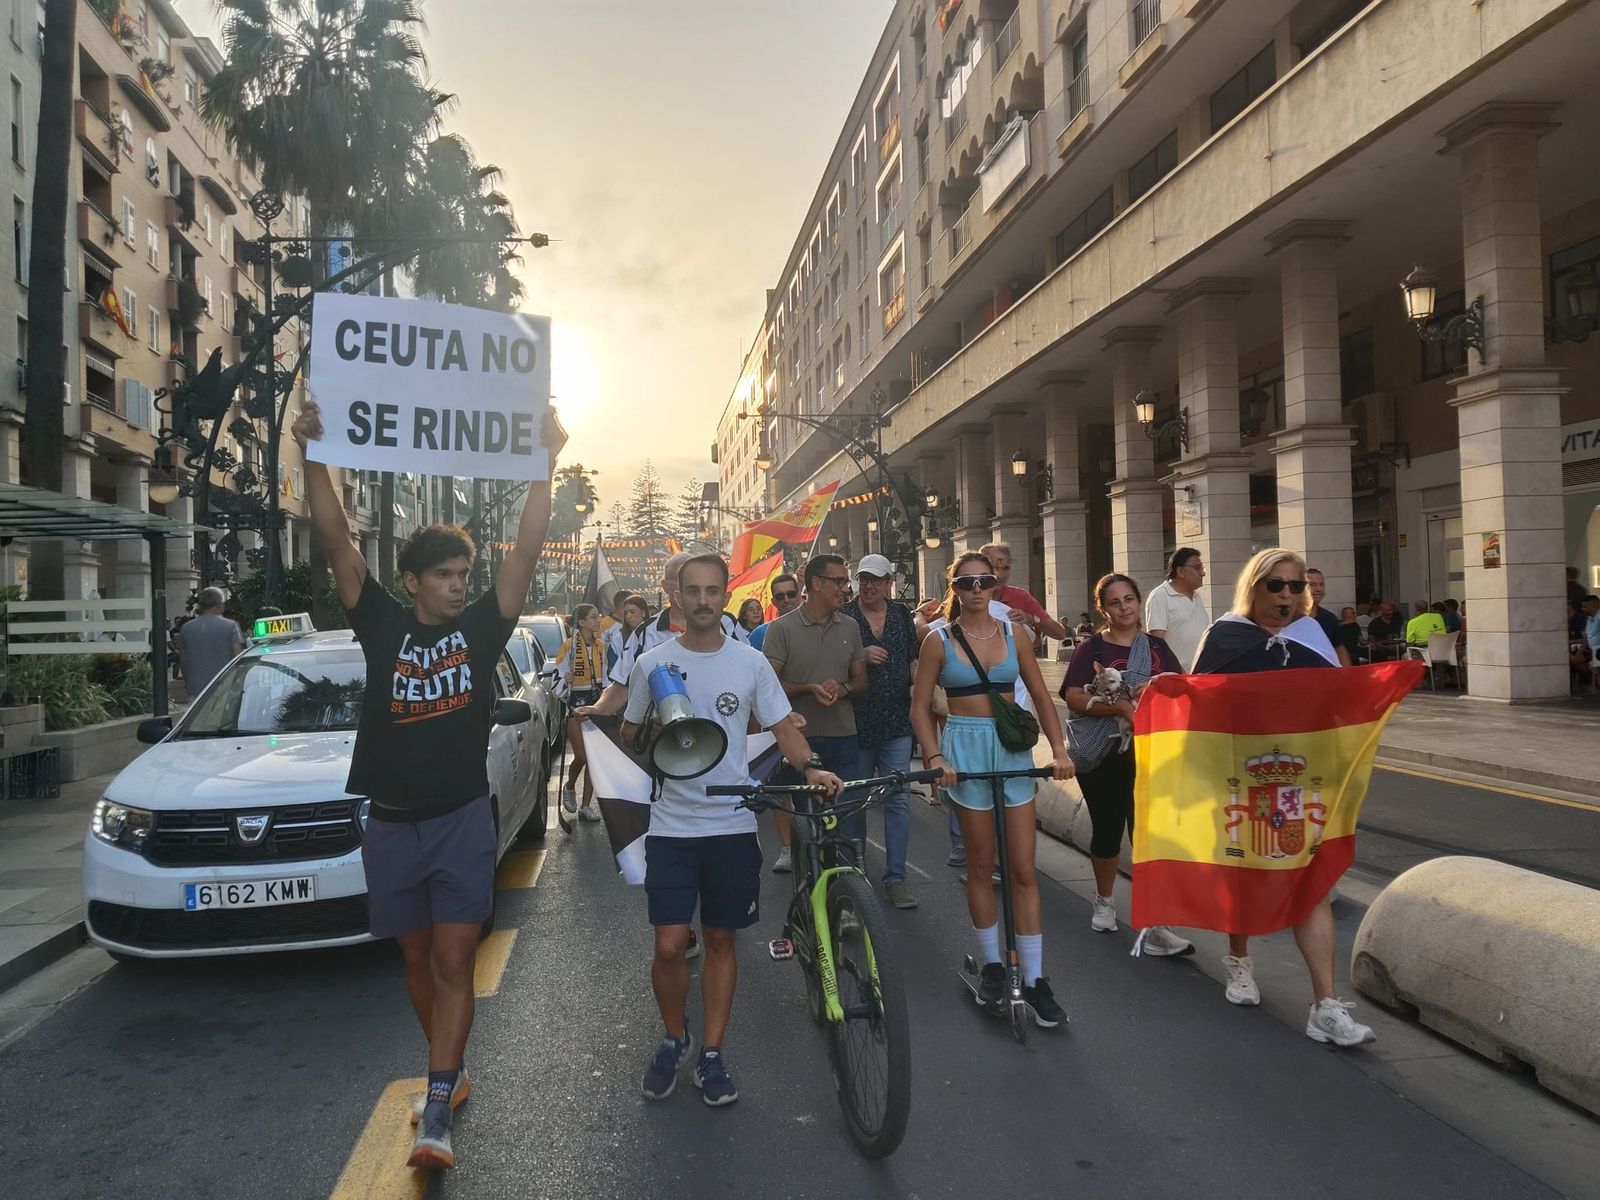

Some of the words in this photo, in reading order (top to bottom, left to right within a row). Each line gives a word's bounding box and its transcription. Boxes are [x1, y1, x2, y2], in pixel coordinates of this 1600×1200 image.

[335, 319, 469, 371] CEUTA
[482, 333, 537, 374] NO
[347, 400, 399, 447] SE
[413, 407, 533, 456] RINDE
[266, 619, 290, 633] TAXI
[393, 663, 472, 701] CEUTA
[390, 701, 405, 713] SE
[410, 693, 472, 713] DEFIENDE
[200, 883, 256, 905] 6162
[265, 879, 309, 901] KMW
